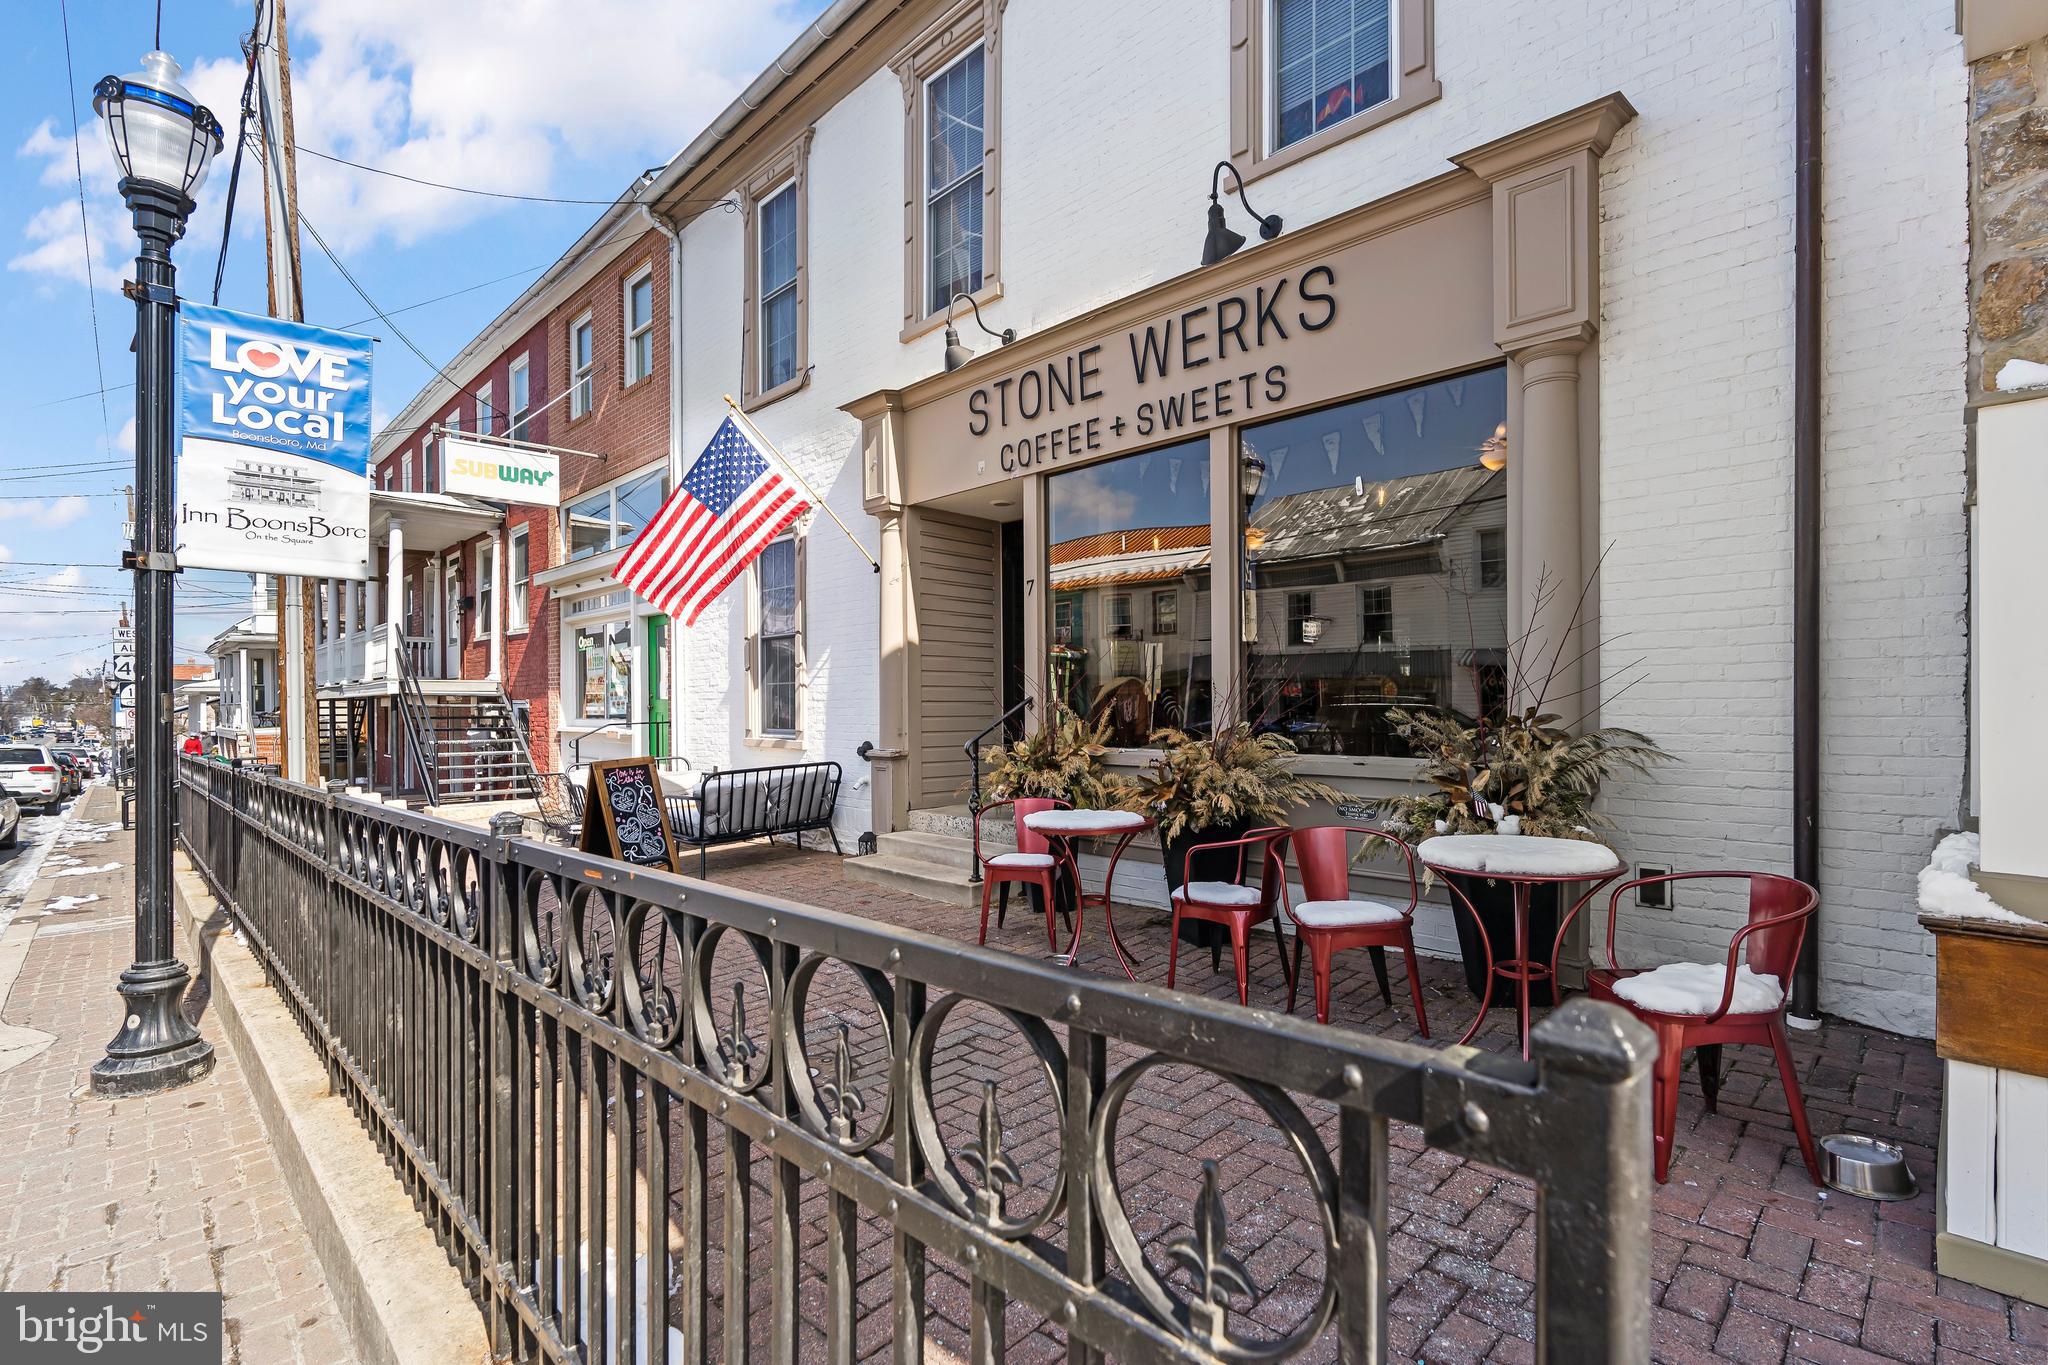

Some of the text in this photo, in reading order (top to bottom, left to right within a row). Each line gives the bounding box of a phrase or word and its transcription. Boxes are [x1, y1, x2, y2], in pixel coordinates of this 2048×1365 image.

[210, 328, 350, 391] LOVE
[969, 266, 1336, 436] STONE WERKS
[223, 375, 335, 412] your
[212, 393, 344, 442] Local
[1000, 417, 1101, 472] COFFEE
[1136, 365, 1287, 436] SWEETS
[232, 430, 327, 451] Boonsboro, Md
[451, 458, 554, 487] SUBWAY
[182, 503, 218, 524] Inn
[245, 531, 314, 546] On the Square
[1026, 579, 1035, 597] 7
[118, 629, 135, 638] WES
[578, 635, 594, 649] Open
[121, 644, 135, 652] AL
[118, 661, 135, 676] 4
[1349, 807, 1375, 815] SMOING
